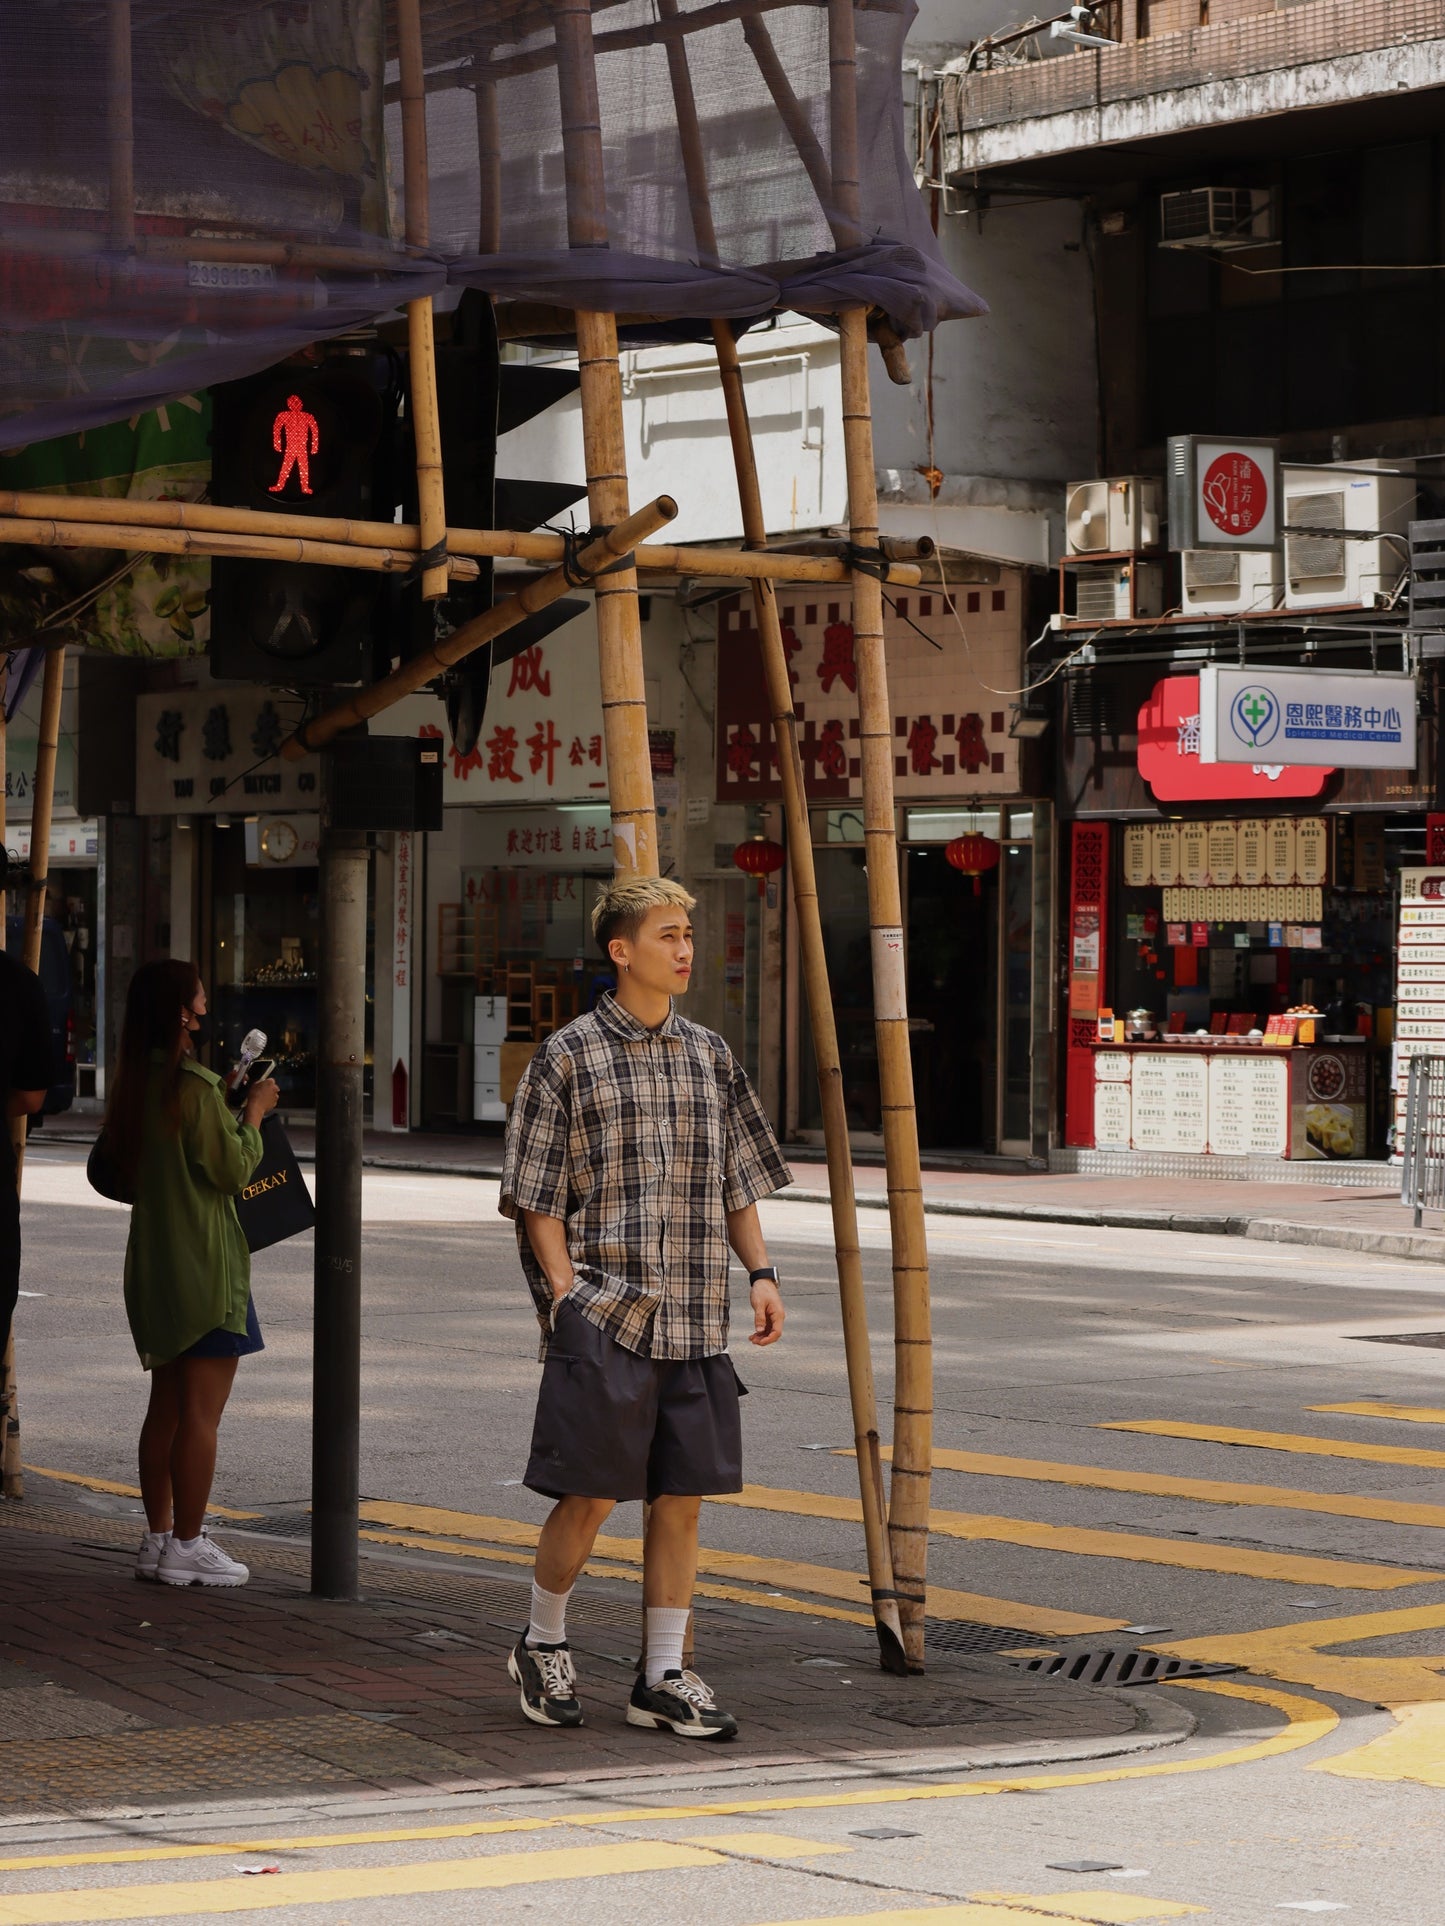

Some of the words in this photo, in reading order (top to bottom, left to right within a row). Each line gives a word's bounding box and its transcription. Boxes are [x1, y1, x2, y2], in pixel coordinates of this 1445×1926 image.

[1239, 460, 1253, 528] 潘芳堂
[1286, 703, 1401, 730] 恩熙醫務中心
[1287, 728, 1327, 739] Splendid
[1330, 730, 1366, 740] Medical
[1369, 732, 1400, 741] Centre
[243, 774, 281, 794] WATCH
[298, 773, 315, 792] CO
[506, 826, 563, 856] 歡迎訂造
[1422, 882, 1441, 896] 潘芳
[241, 1169, 288, 1201] CEEKAY
